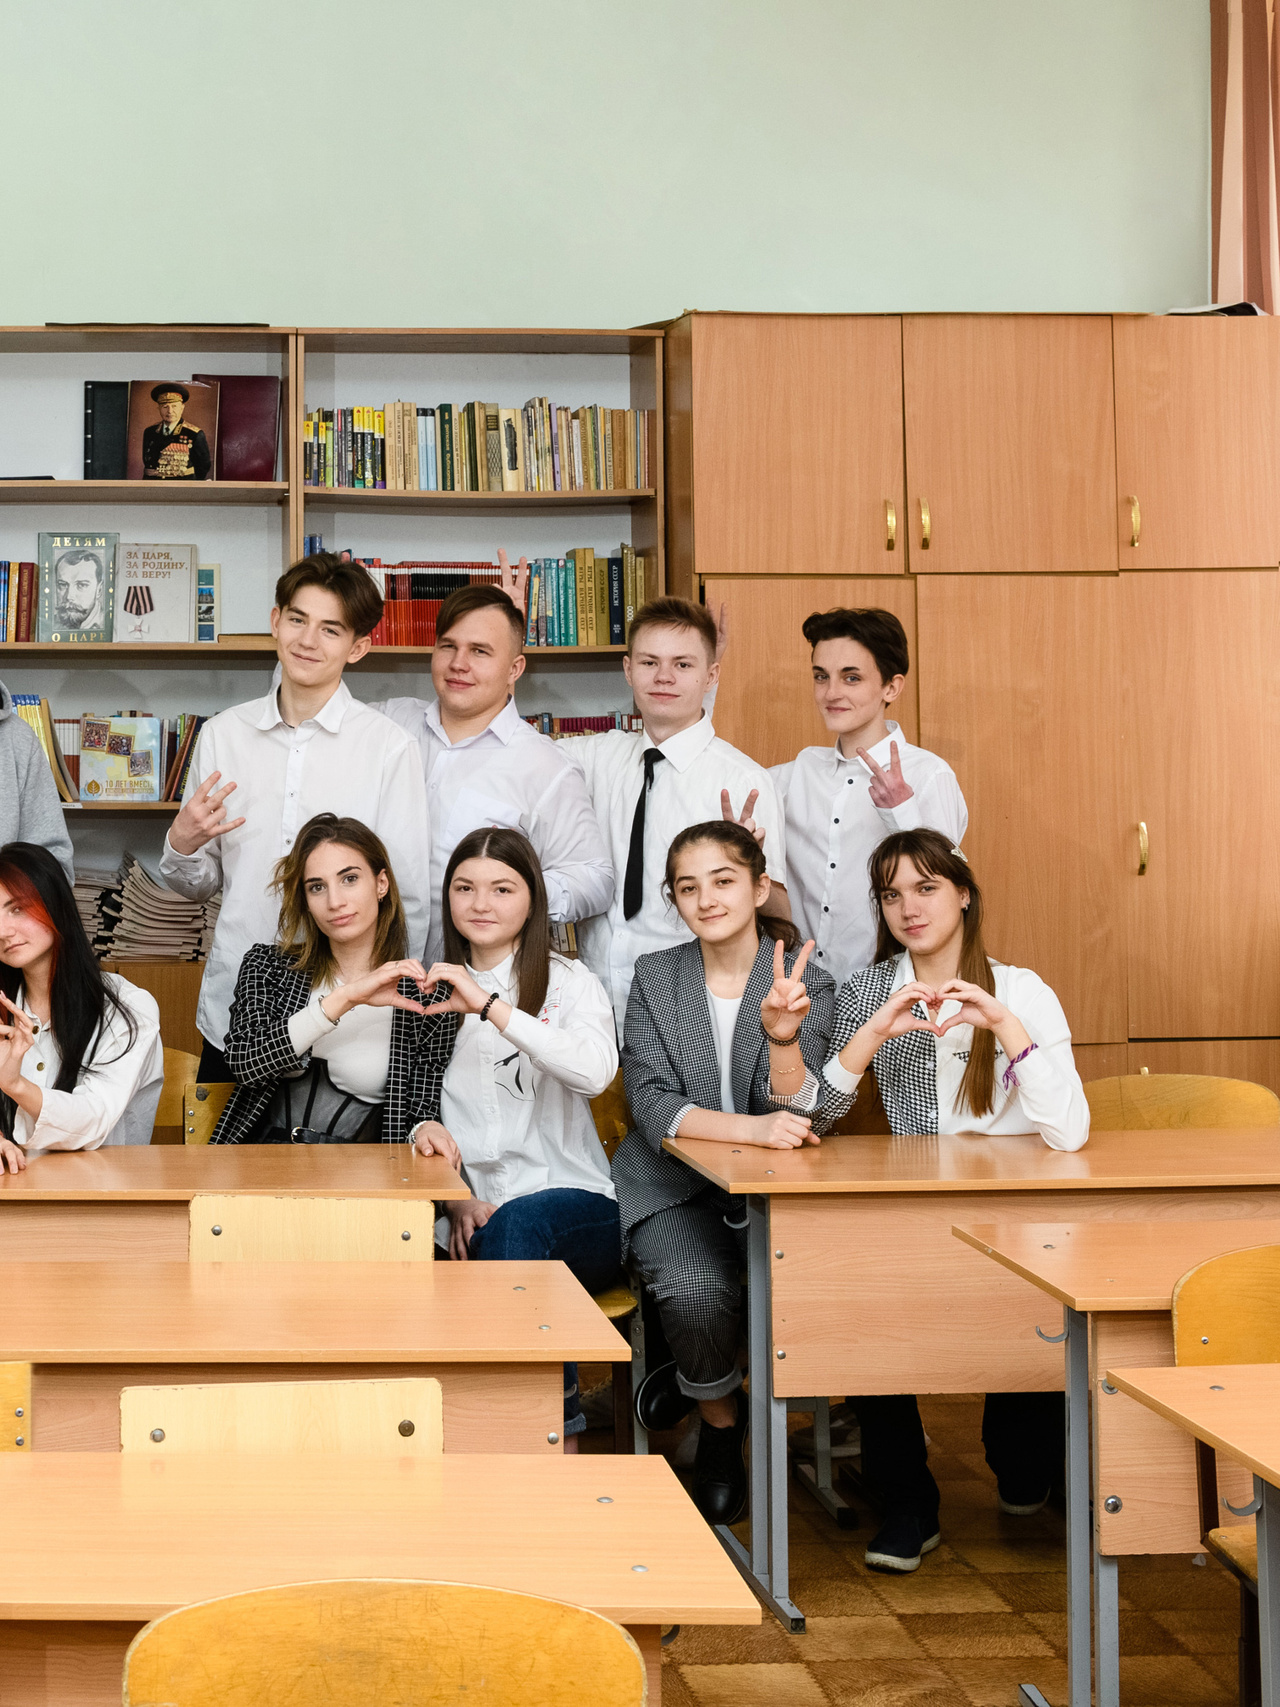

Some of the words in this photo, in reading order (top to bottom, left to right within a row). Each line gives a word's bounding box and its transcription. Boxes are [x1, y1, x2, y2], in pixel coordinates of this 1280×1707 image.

[51, 536, 108, 548] ДЕТЯМ
[126, 552, 139, 560] ЗА
[142, 551, 173, 562] ЦАРЯ,
[126, 561, 139, 569] ЗА
[142, 561, 189, 571] РОДИНУ,
[126, 571, 139, 579] ЗА
[141, 570, 172, 579] ВЕРУ!
[626, 605, 634, 622] 3000
[51, 632, 61, 643] О
[105, 780, 114, 788] 10
[115, 780, 128, 788] ЛЕТ
